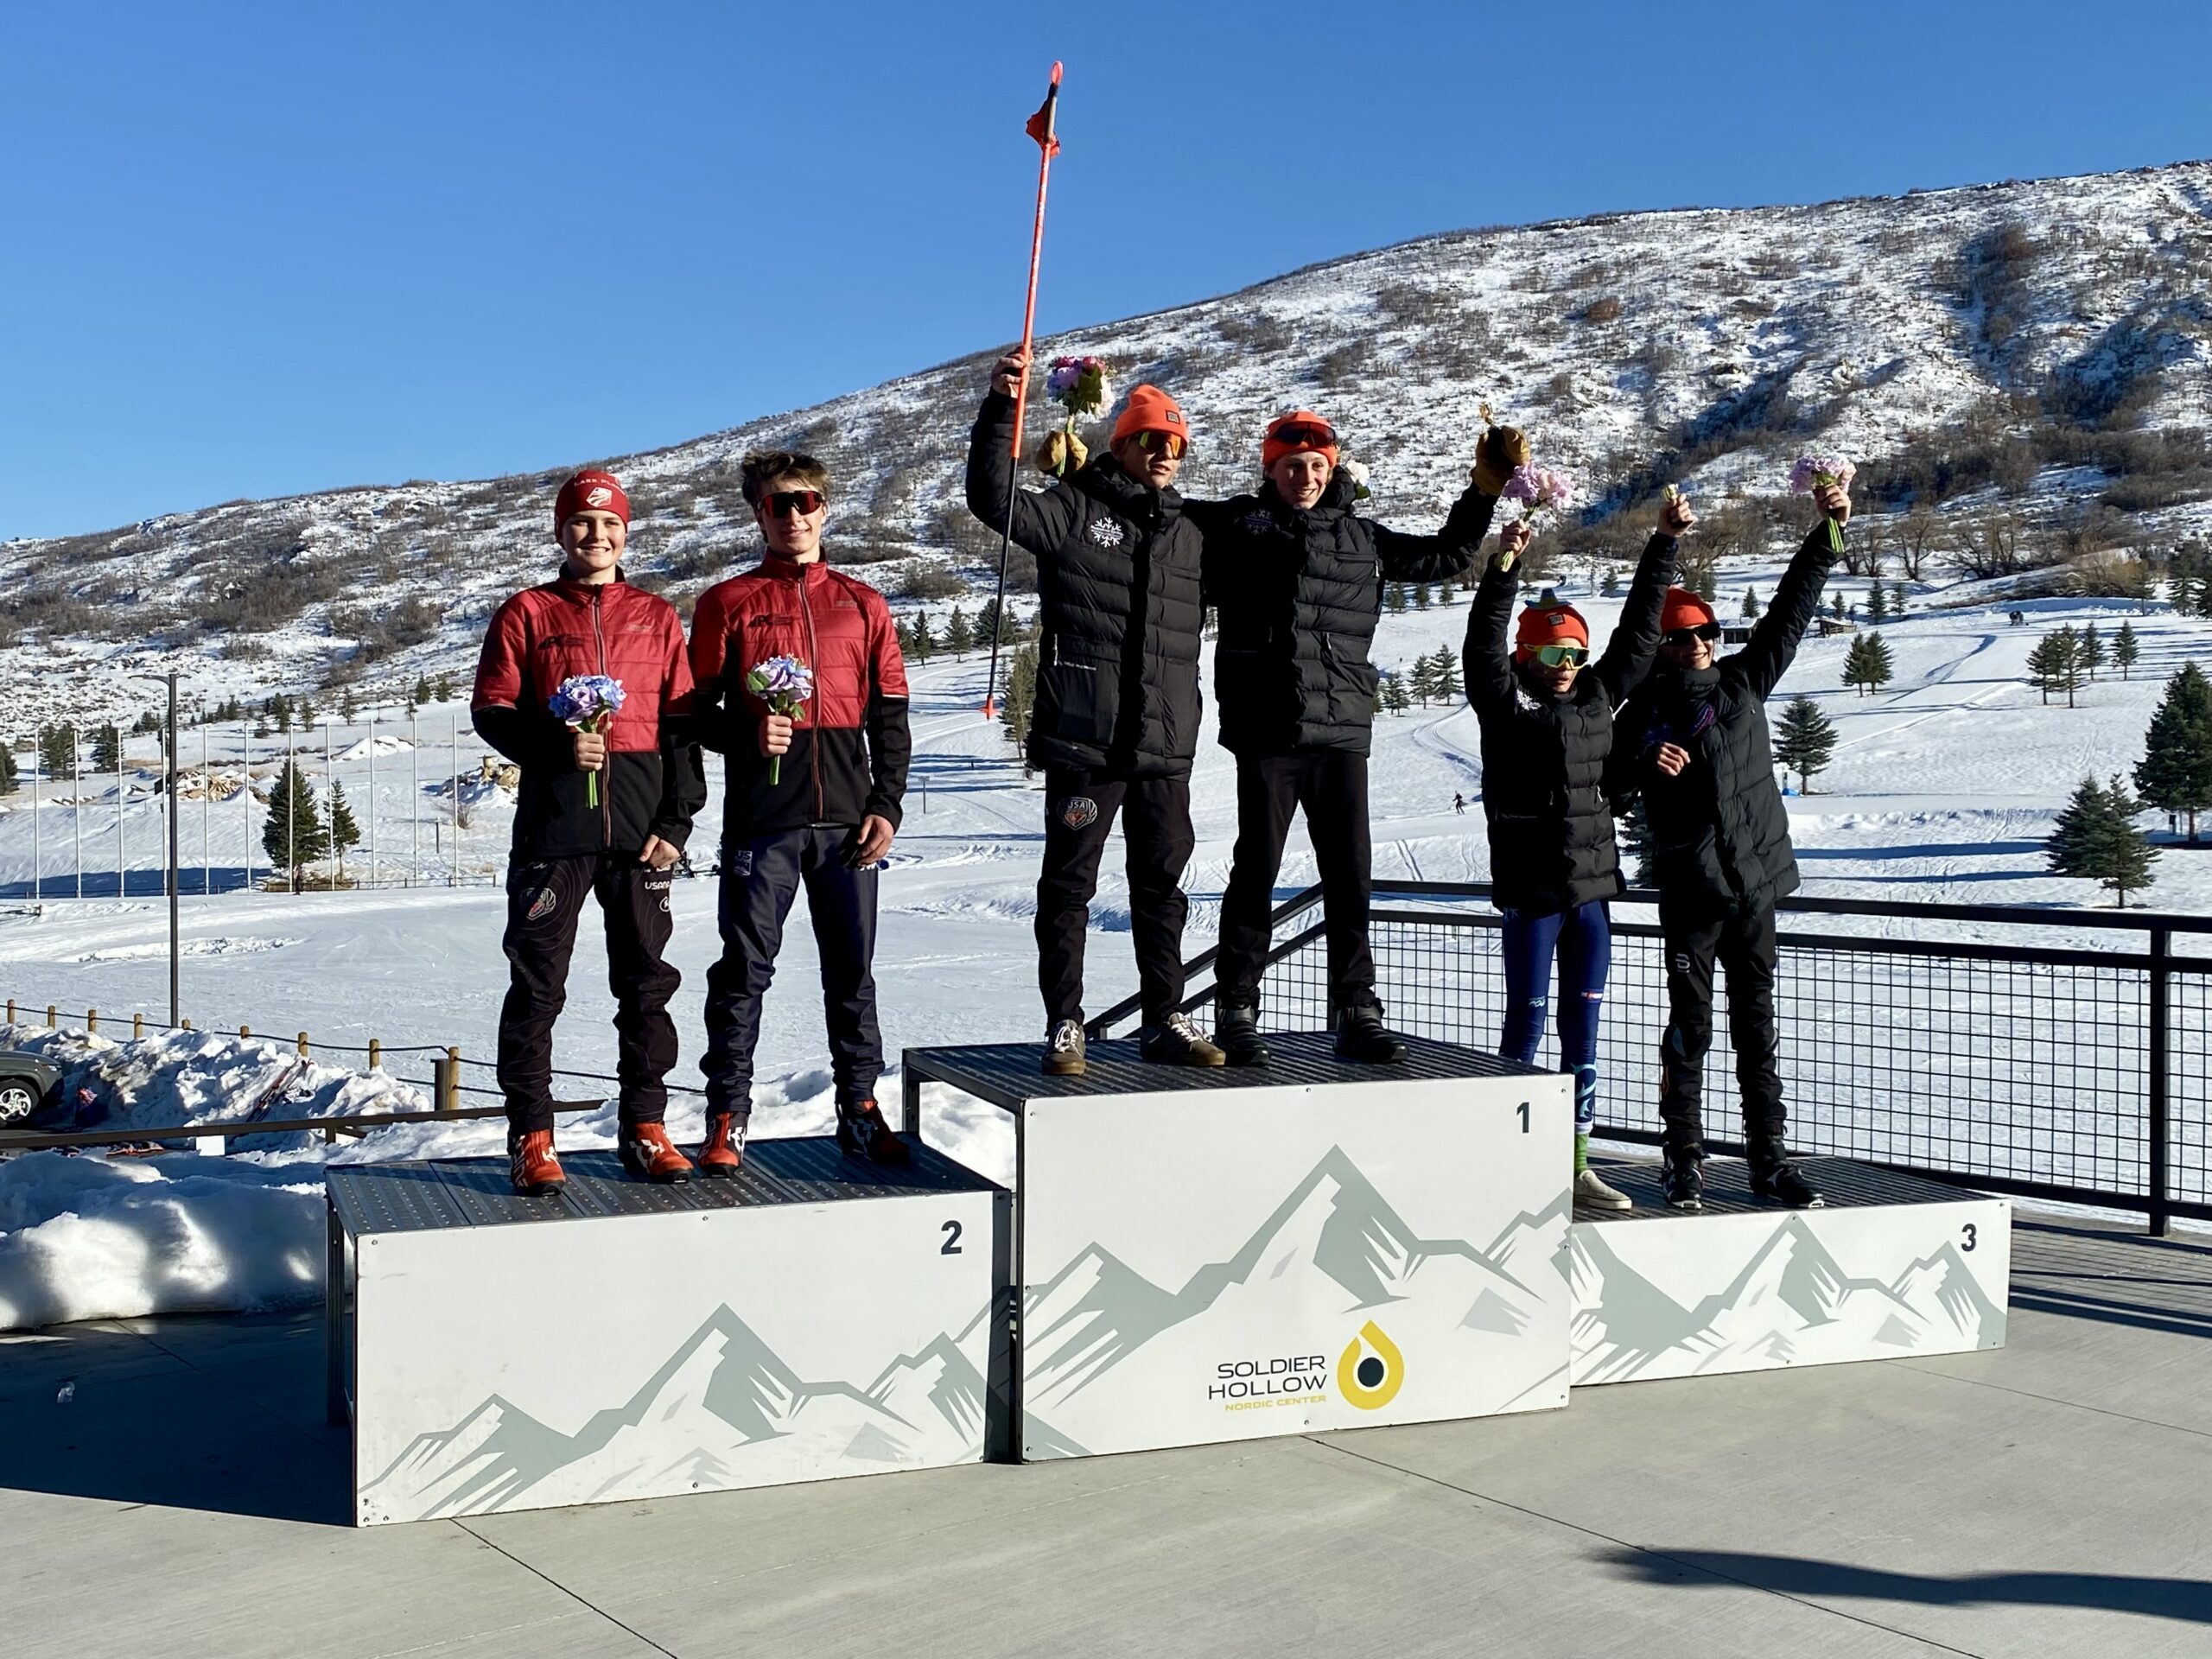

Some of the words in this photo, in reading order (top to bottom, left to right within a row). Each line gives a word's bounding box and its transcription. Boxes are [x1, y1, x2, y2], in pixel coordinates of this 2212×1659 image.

[1516, 1102, 1529, 1134] 1
[941, 1220, 962, 1255] 2
[1961, 1223, 1976, 1252] 3
[1217, 1355, 1325, 1379] SOLDIER
[1209, 1374, 1327, 1400] HOLLOW
[1224, 1400, 1274, 1412] NORDIC
[1276, 1395, 1327, 1407] CENTER
